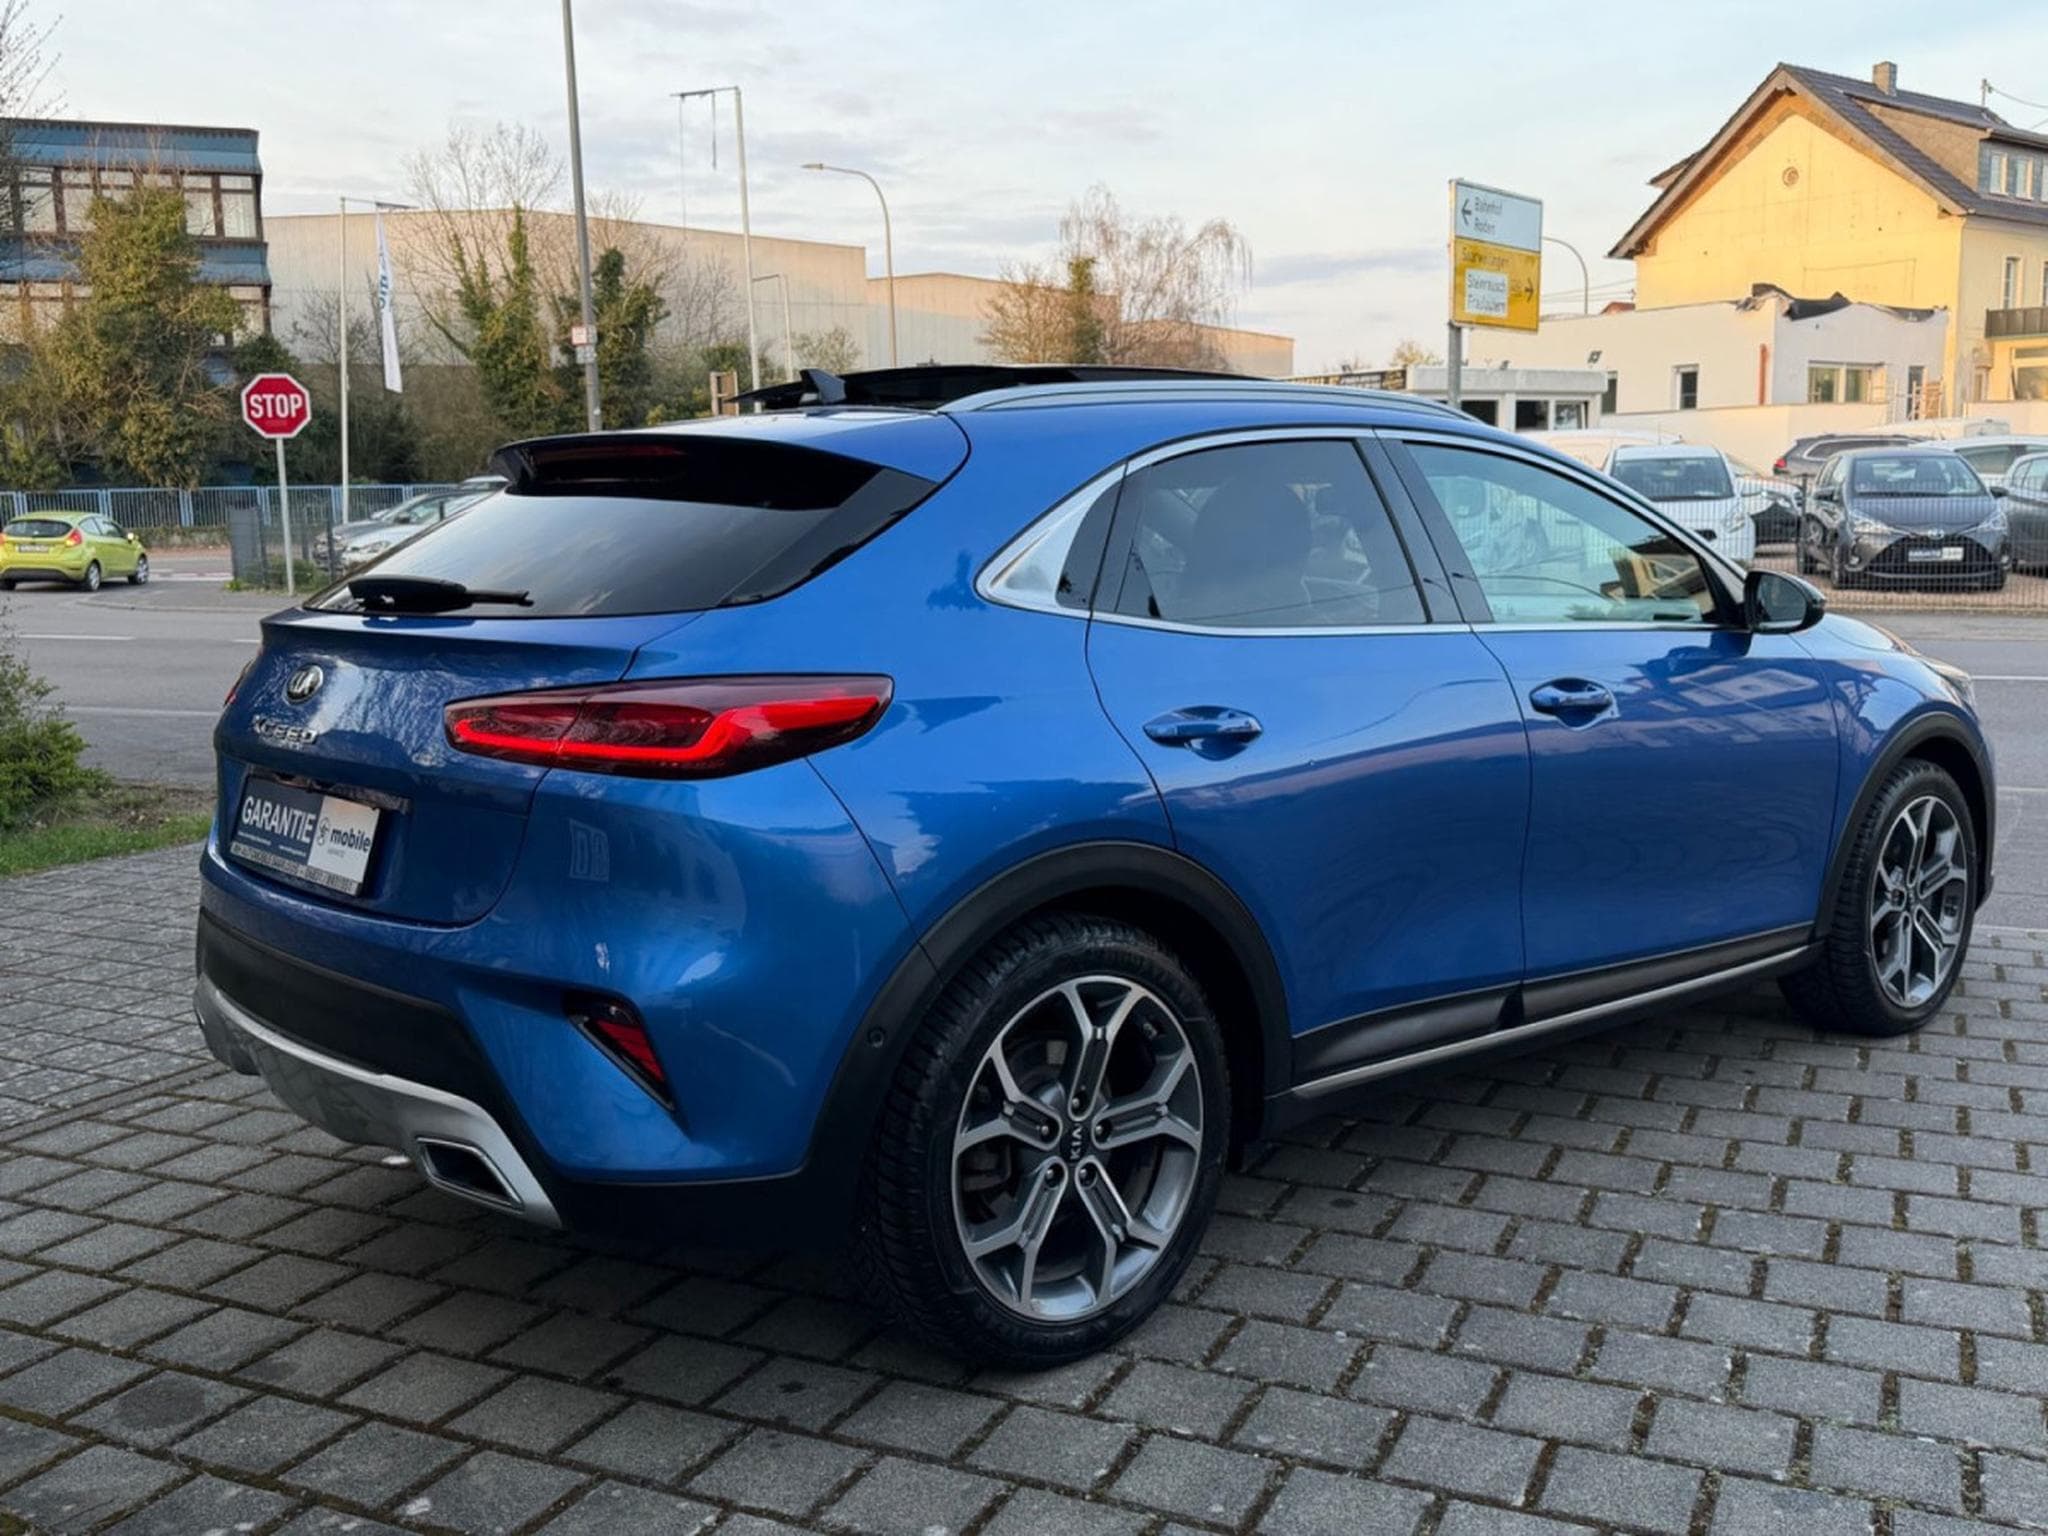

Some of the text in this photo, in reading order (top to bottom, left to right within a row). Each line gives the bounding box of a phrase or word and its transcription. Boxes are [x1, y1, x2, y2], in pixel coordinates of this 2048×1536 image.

[249, 393, 304, 419] STOP
[241, 796, 318, 845] GARANTIE
[329, 827, 372, 852] mobile
[1069, 1124, 1083, 1160] KIA
